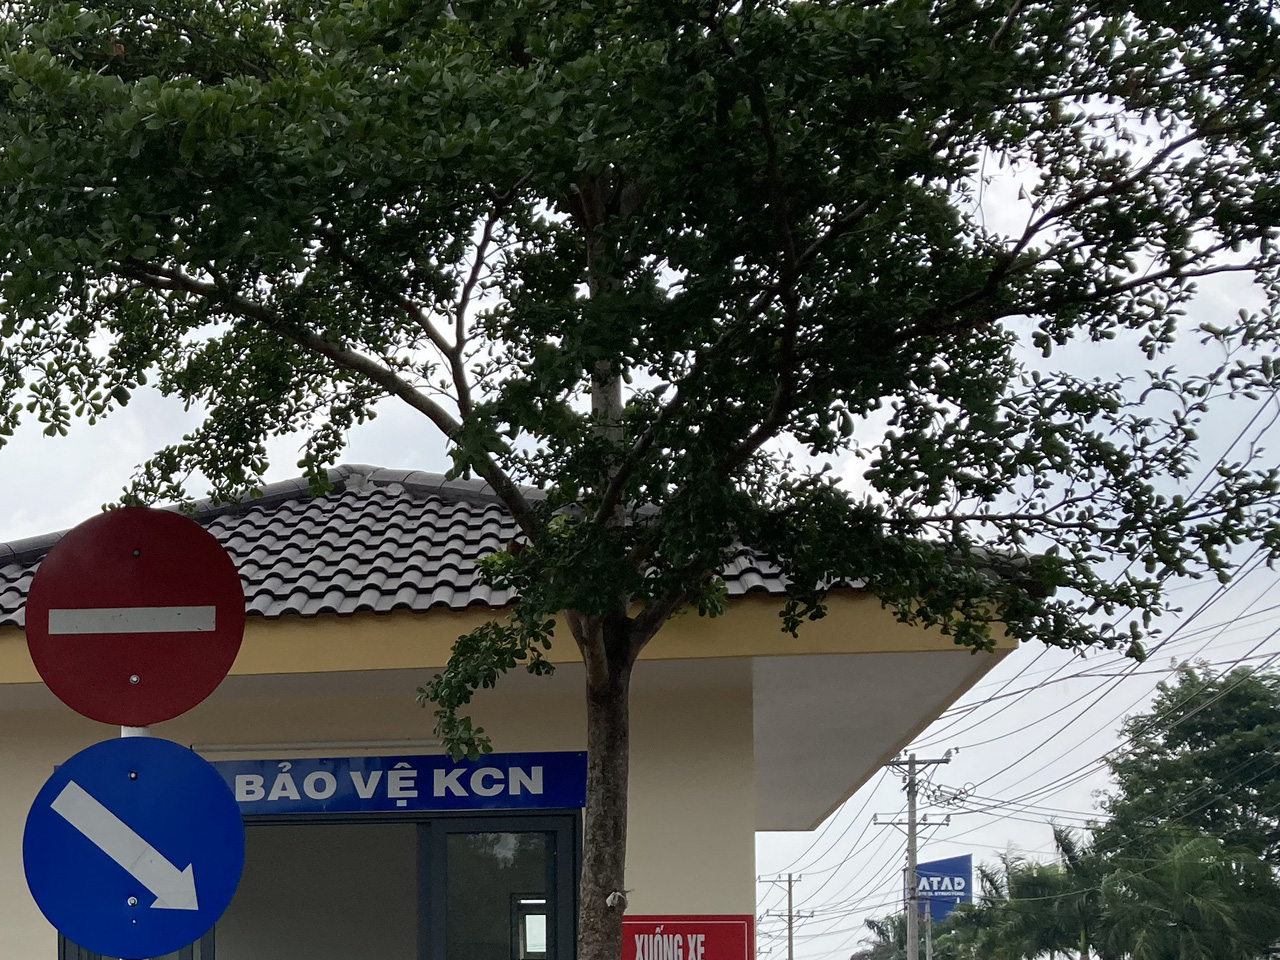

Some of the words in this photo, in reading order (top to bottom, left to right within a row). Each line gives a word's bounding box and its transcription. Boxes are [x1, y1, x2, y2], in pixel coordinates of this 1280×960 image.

[234, 762, 337, 801] BẢO
[350, 762, 418, 806] VỆ
[433, 766, 543, 797] KCN
[918, 877, 966, 890] ATAD
